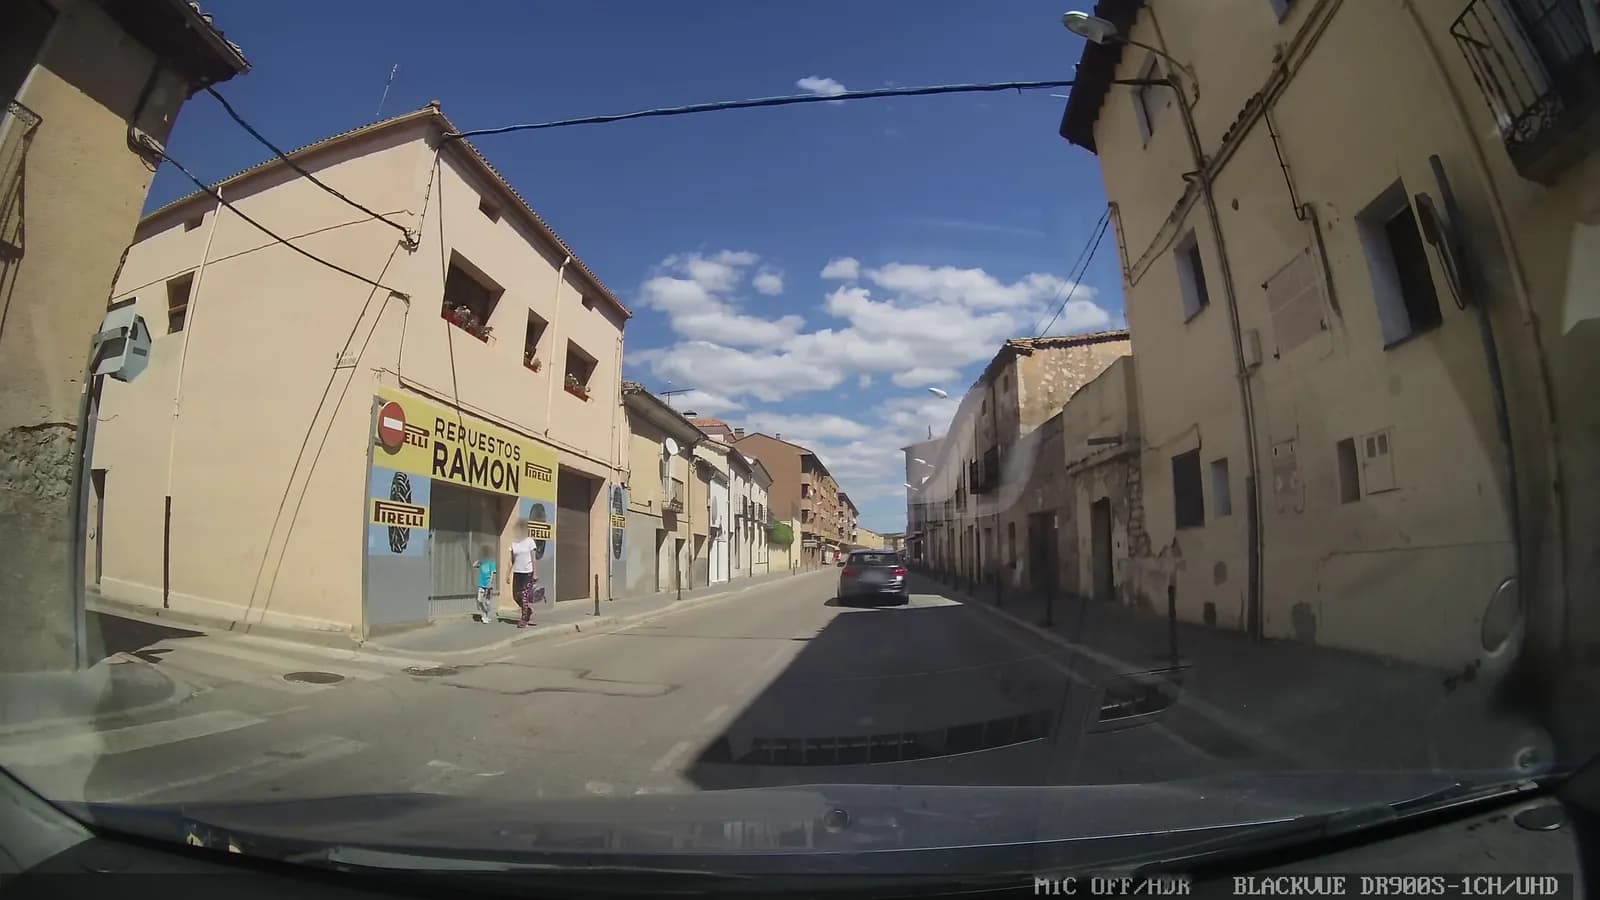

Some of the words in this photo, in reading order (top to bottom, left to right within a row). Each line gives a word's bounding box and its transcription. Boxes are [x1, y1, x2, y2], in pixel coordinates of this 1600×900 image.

[404, 423, 430, 449] ELLI
[434, 417, 521, 462] REPUESTOS
[432, 441, 520, 494] RAMON
[525, 461, 553, 483] PIRELLI
[374, 500, 426, 527] PIRELLI
[527, 522, 552, 539] IRELLI
